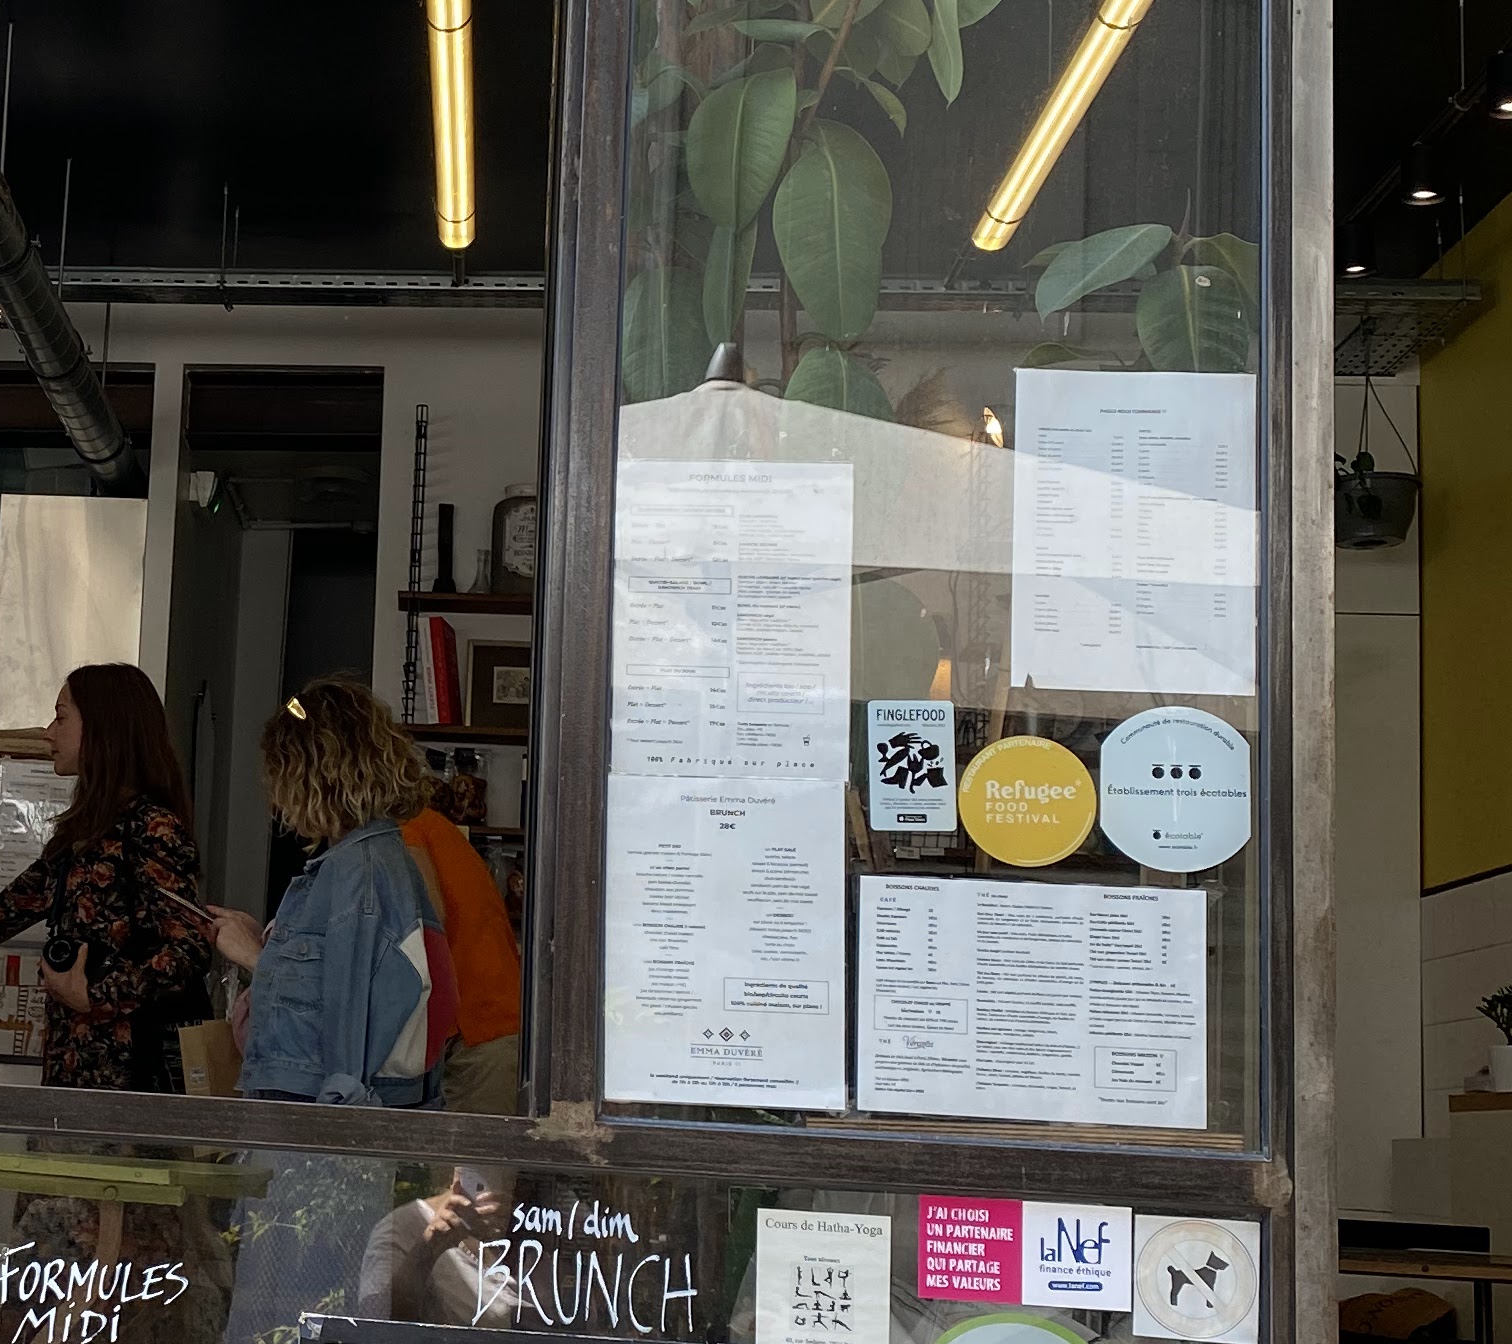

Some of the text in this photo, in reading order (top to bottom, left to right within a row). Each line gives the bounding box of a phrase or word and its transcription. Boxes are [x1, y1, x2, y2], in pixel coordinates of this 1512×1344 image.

[876, 708, 946, 723] FINGLEFOOD
[962, 748, 998, 794] RESTAURANT
[985, 779, 1077, 805] Refugee
[1107, 783, 1248, 798] Établissement trois écotables
[709, 808, 746, 817] BRUNCH
[985, 801, 1028, 812] FOOD
[719, 822, 736, 830] 28€
[985, 813, 1060, 824] FESTIVAL
[690, 1046, 763, 1057] EMMA DUVÉRÉ
[950, 1207, 990, 1223] CHOISI
[764, 1217, 884, 1238] Cours de Hatha-Yoga
[926, 1222, 1014, 1242] UN PARTENAIRE
[926, 1239, 986, 1257] FINANCIER
[926, 1256, 1001, 1275] QUI PARTAGE
[1038, 1263, 1112, 1277] finance éthique
[472, 1238, 698, 1333] BRUNCH
[925, 1273, 1001, 1291] MES VALEURS
